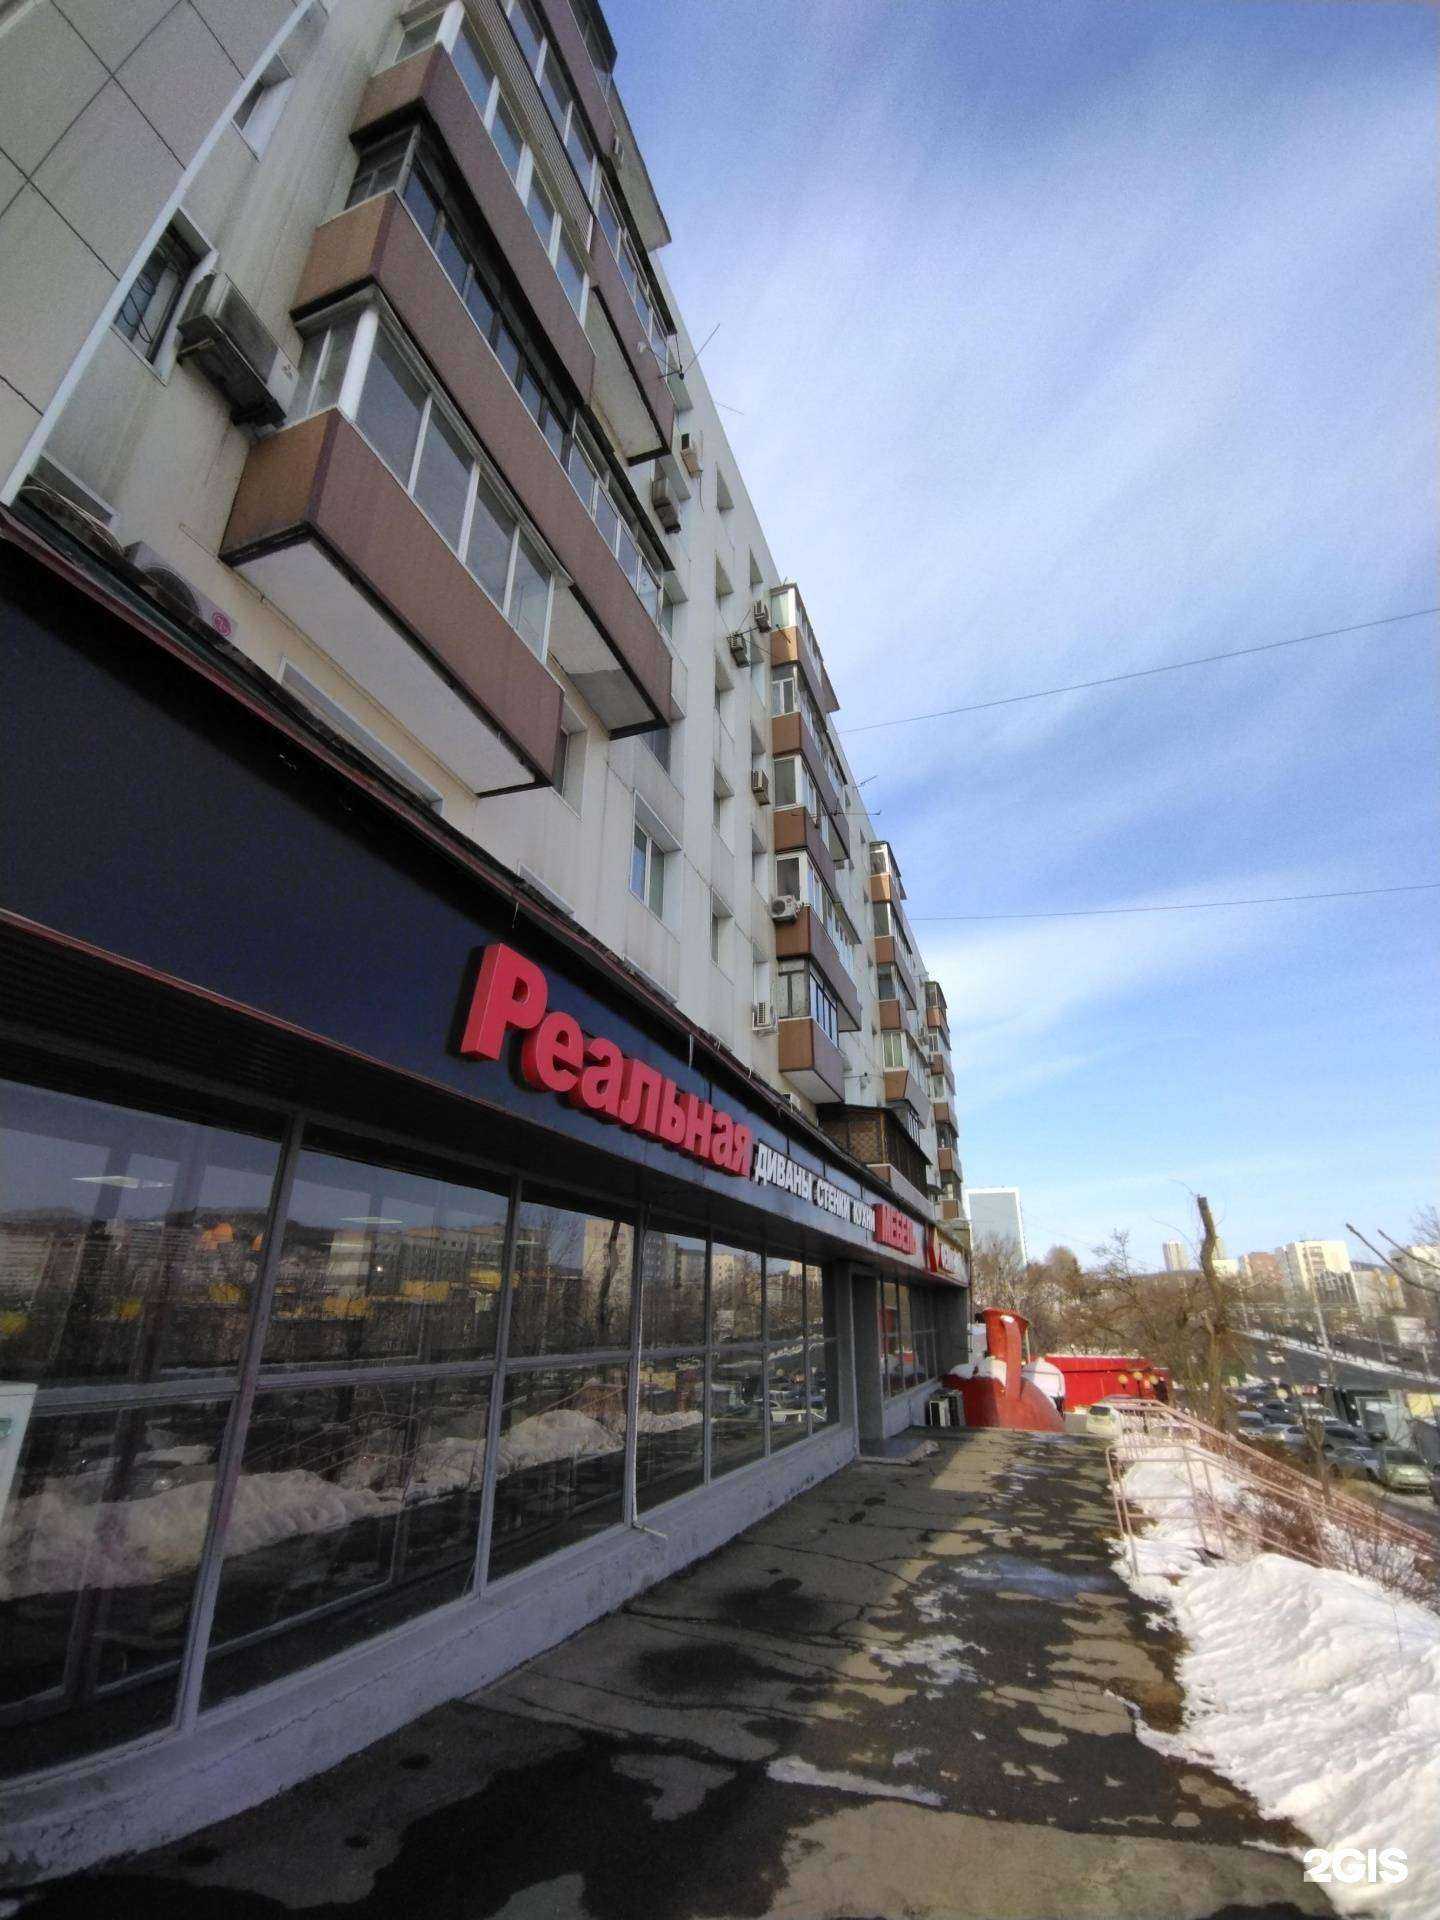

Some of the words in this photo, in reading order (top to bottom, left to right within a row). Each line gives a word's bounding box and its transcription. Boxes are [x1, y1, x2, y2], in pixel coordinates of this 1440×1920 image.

[461, 943, 753, 1177] Реальная
[754, 1141, 812, 1201] ДИВАНЫ
[816, 1178, 850, 1222] СТЕНКИ
[852, 1199, 876, 1232] КУХНИ
